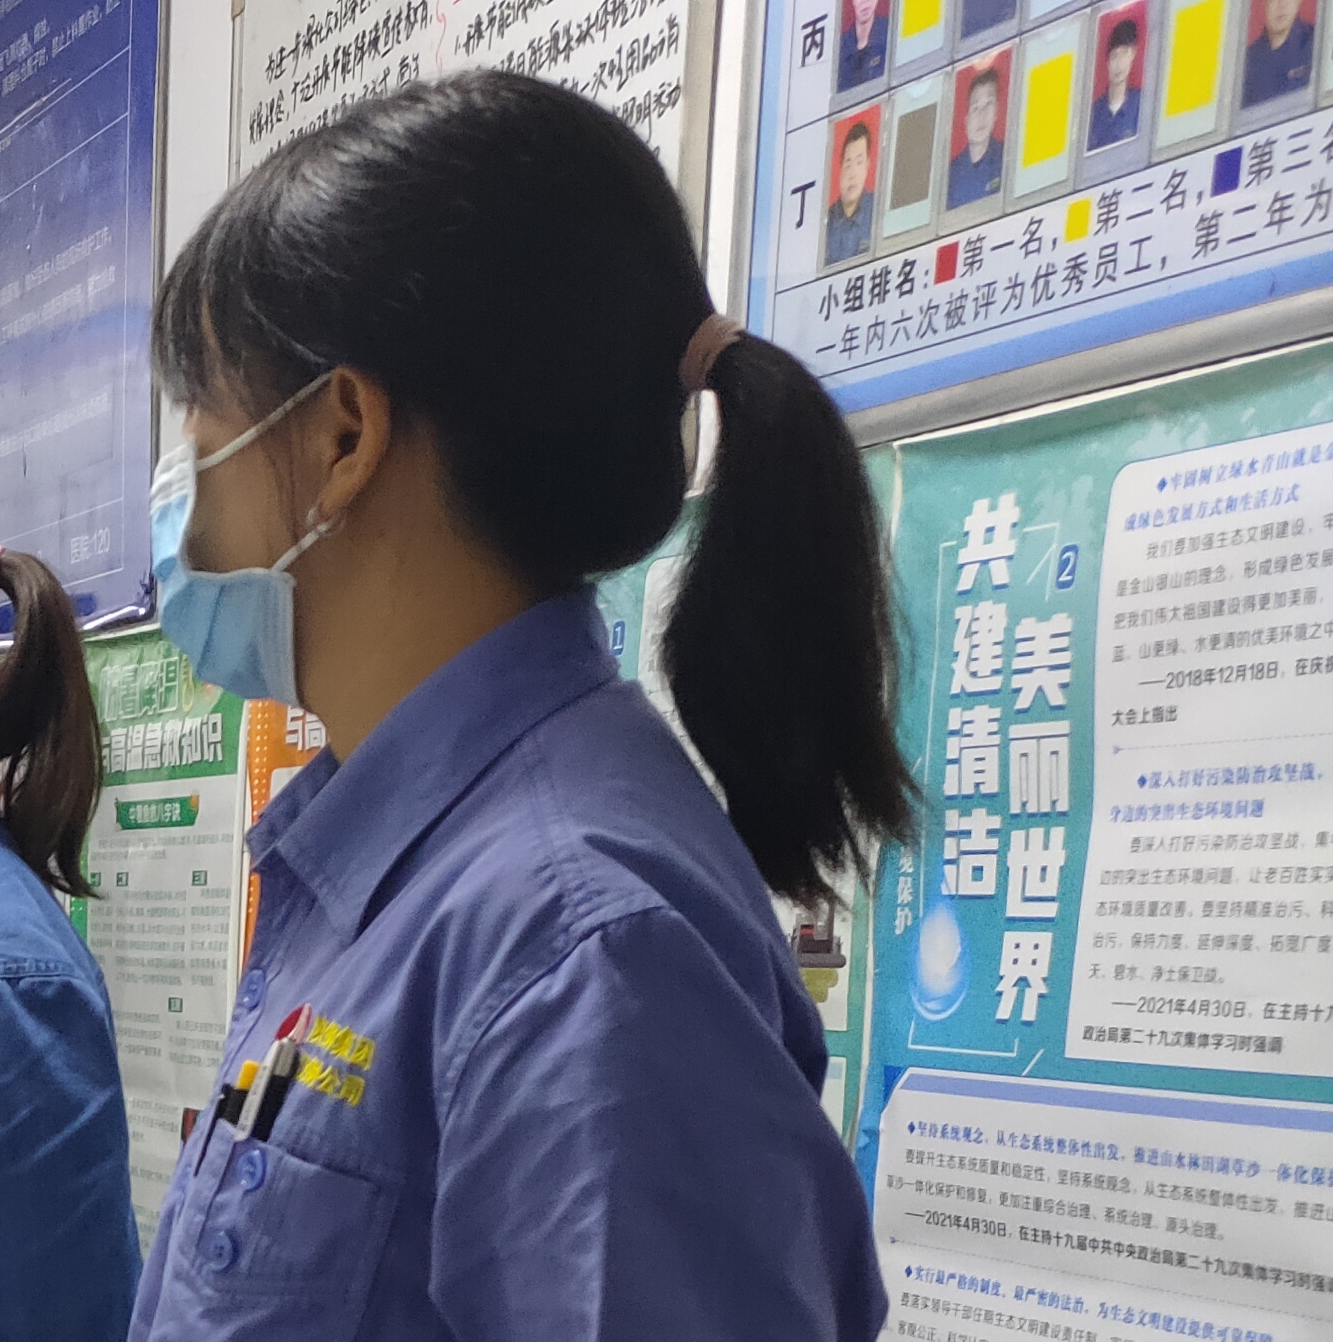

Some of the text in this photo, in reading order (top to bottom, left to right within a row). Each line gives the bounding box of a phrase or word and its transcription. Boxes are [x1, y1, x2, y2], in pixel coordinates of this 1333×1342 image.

[799, 14, 829, 68] 丙
[790, 180, 817, 230] 丁
[1056, 550, 1076, 585] 2
[941, 491, 1021, 900] 共建清洁
[1111, 705, 1179, 727] 大会上指出
[995, 612, 1072, 1024] 美丽世界
[1129, 830, 1333, 853] 要深入打好污染防治攻坚战，集
[1082, 1025, 1284, 1054] 政治局第二十九次集体学习时强调
